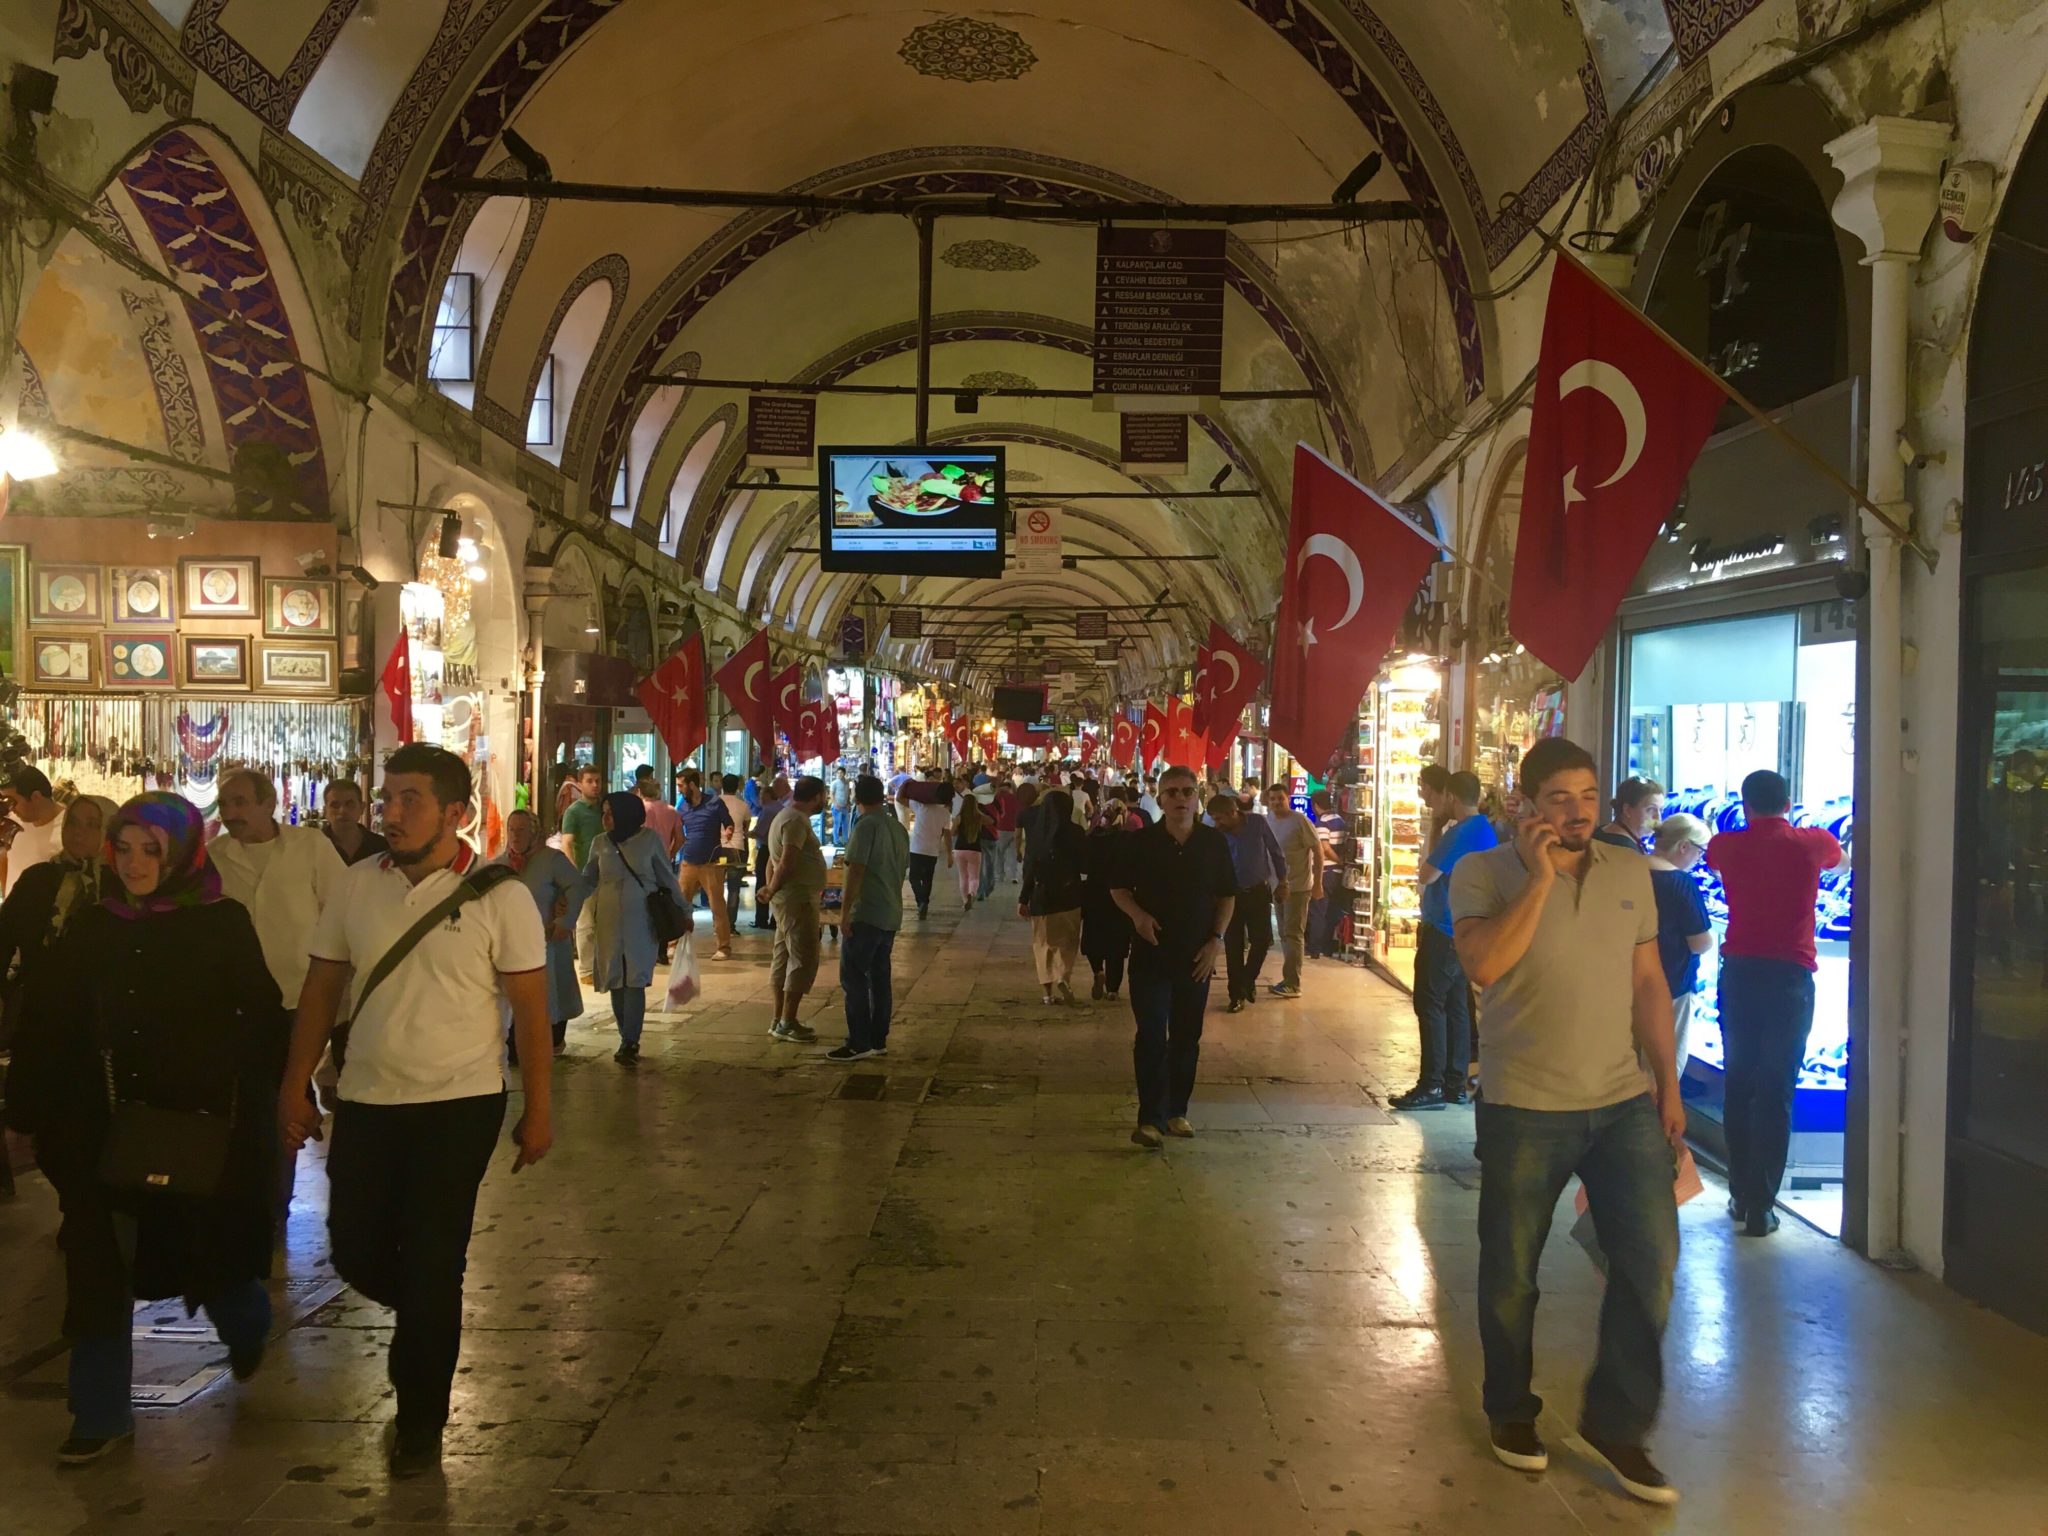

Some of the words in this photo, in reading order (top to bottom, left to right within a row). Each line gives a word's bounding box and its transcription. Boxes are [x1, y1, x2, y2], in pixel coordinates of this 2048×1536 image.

[1116, 261, 1166, 272] KALPAKÇILAR
[1115, 291, 1145, 300] RESSAM
[1146, 292, 1192, 301] BASMACILAR
[1113, 337, 1142, 346] SANDAL
[1113, 353, 1151, 361] ESNAFLAR
[1112, 368, 1152, 378] SORGUÇLU
[1174, 369, 1185, 377] WC
[1112, 383, 1137, 394] ÇUKUR
[1019, 536, 1028, 544] NO
[1030, 536, 1058, 544] SMOKING
